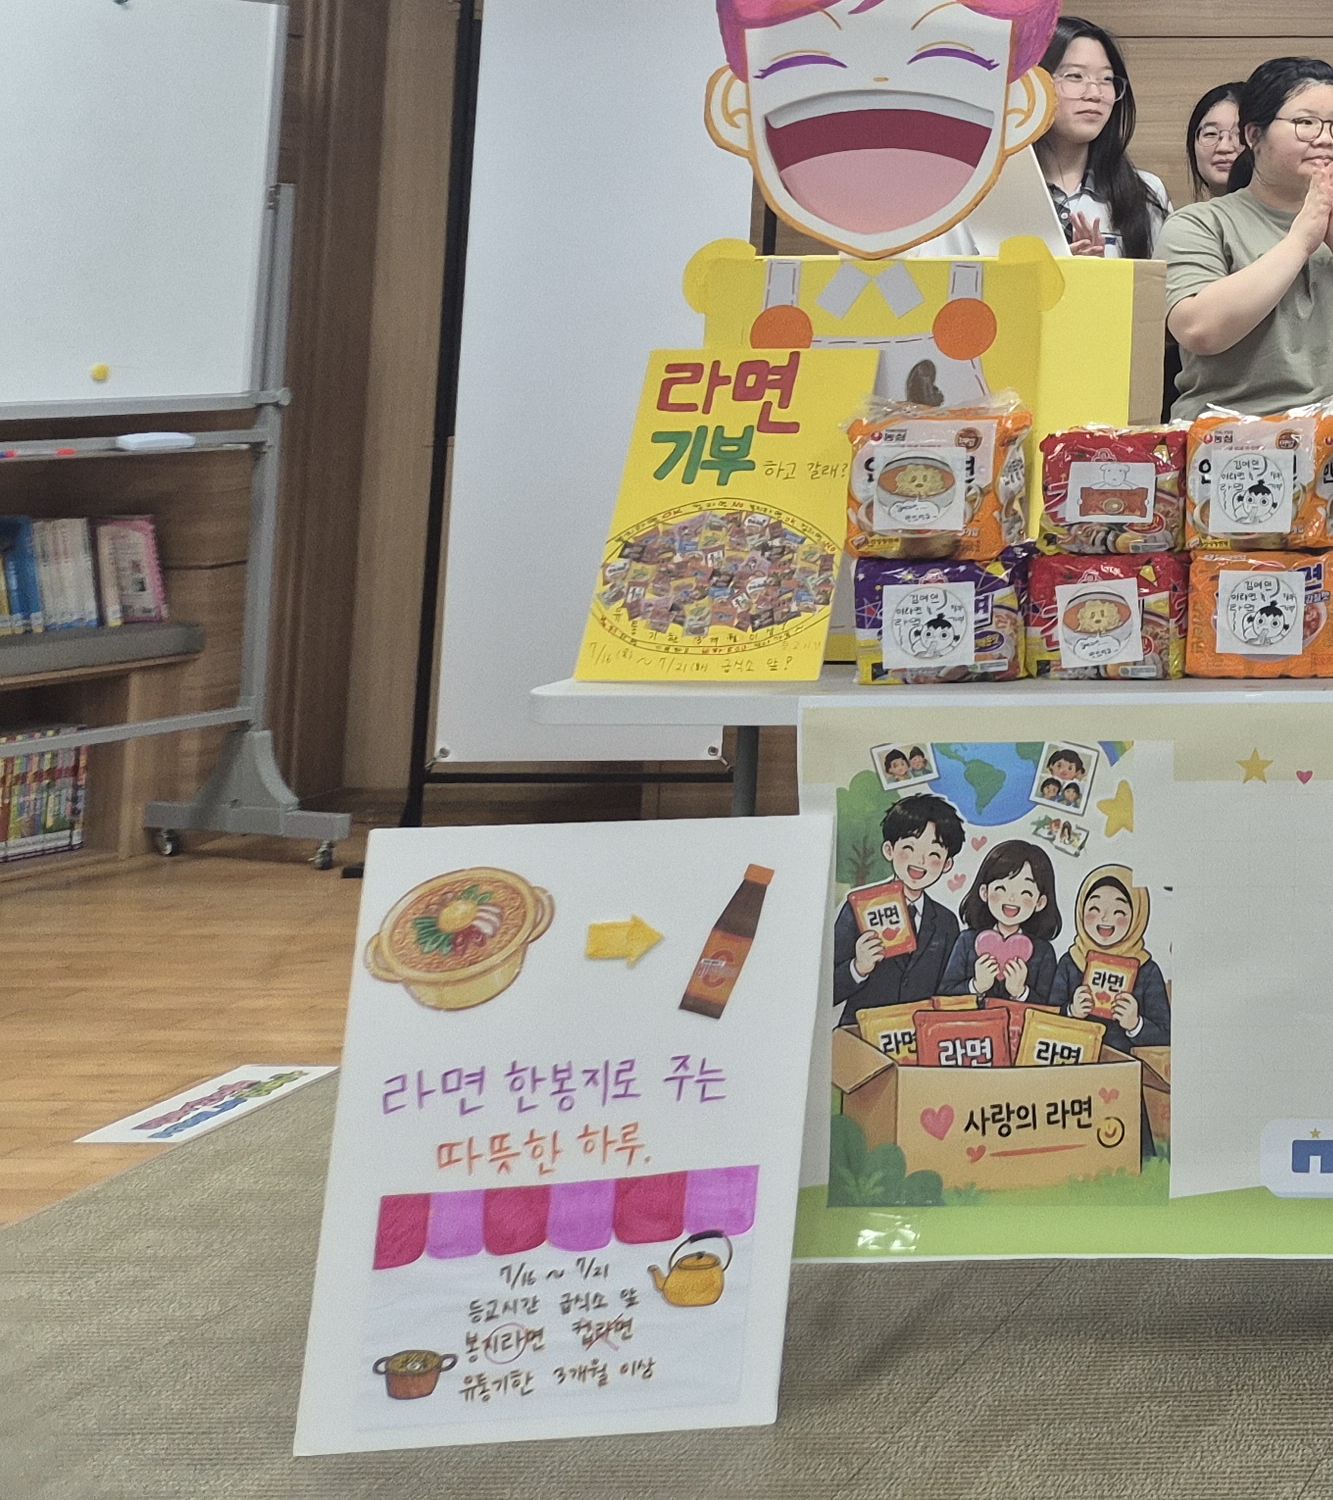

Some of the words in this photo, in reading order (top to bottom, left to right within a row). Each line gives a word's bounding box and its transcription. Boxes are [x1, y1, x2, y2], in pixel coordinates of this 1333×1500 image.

[656, 350, 800, 434] 라면
[651, 425, 756, 486] 기부
[763, 461, 797, 481] 하고
[867, 907, 900, 928] 라면
[1090, 970, 1124, 992] 라면
[938, 1037, 993, 1067] 라면
[1035, 1040, 1083, 1064] 라면
[382, 1065, 487, 1116] 라면
[503, 1058, 642, 1115] 한봉지로
[663, 1053, 728, 1103] 주는
[963, 1100, 1037, 1138] 사랑의
[1046, 1095, 1093, 1130] 라면
[437, 1126, 562, 1178] 따뜻한
[577, 1121, 653, 1168] 하루.
[499, 1261, 535, 1289] 7/16
[576, 1257, 609, 1280] 7/21
[468, 1295, 540, 1324] 등교시간
[559, 1290, 608, 1316] 급식소
[620, 1287, 640, 1310] 앞
[465, 1326, 546, 1361] 봉지라면
[571, 1317, 634, 1346] 컵라면
[459, 1370, 535, 1402] 유통기한
[553, 1362, 610, 1388] 3개월
[620, 1357, 656, 1381] 이상
